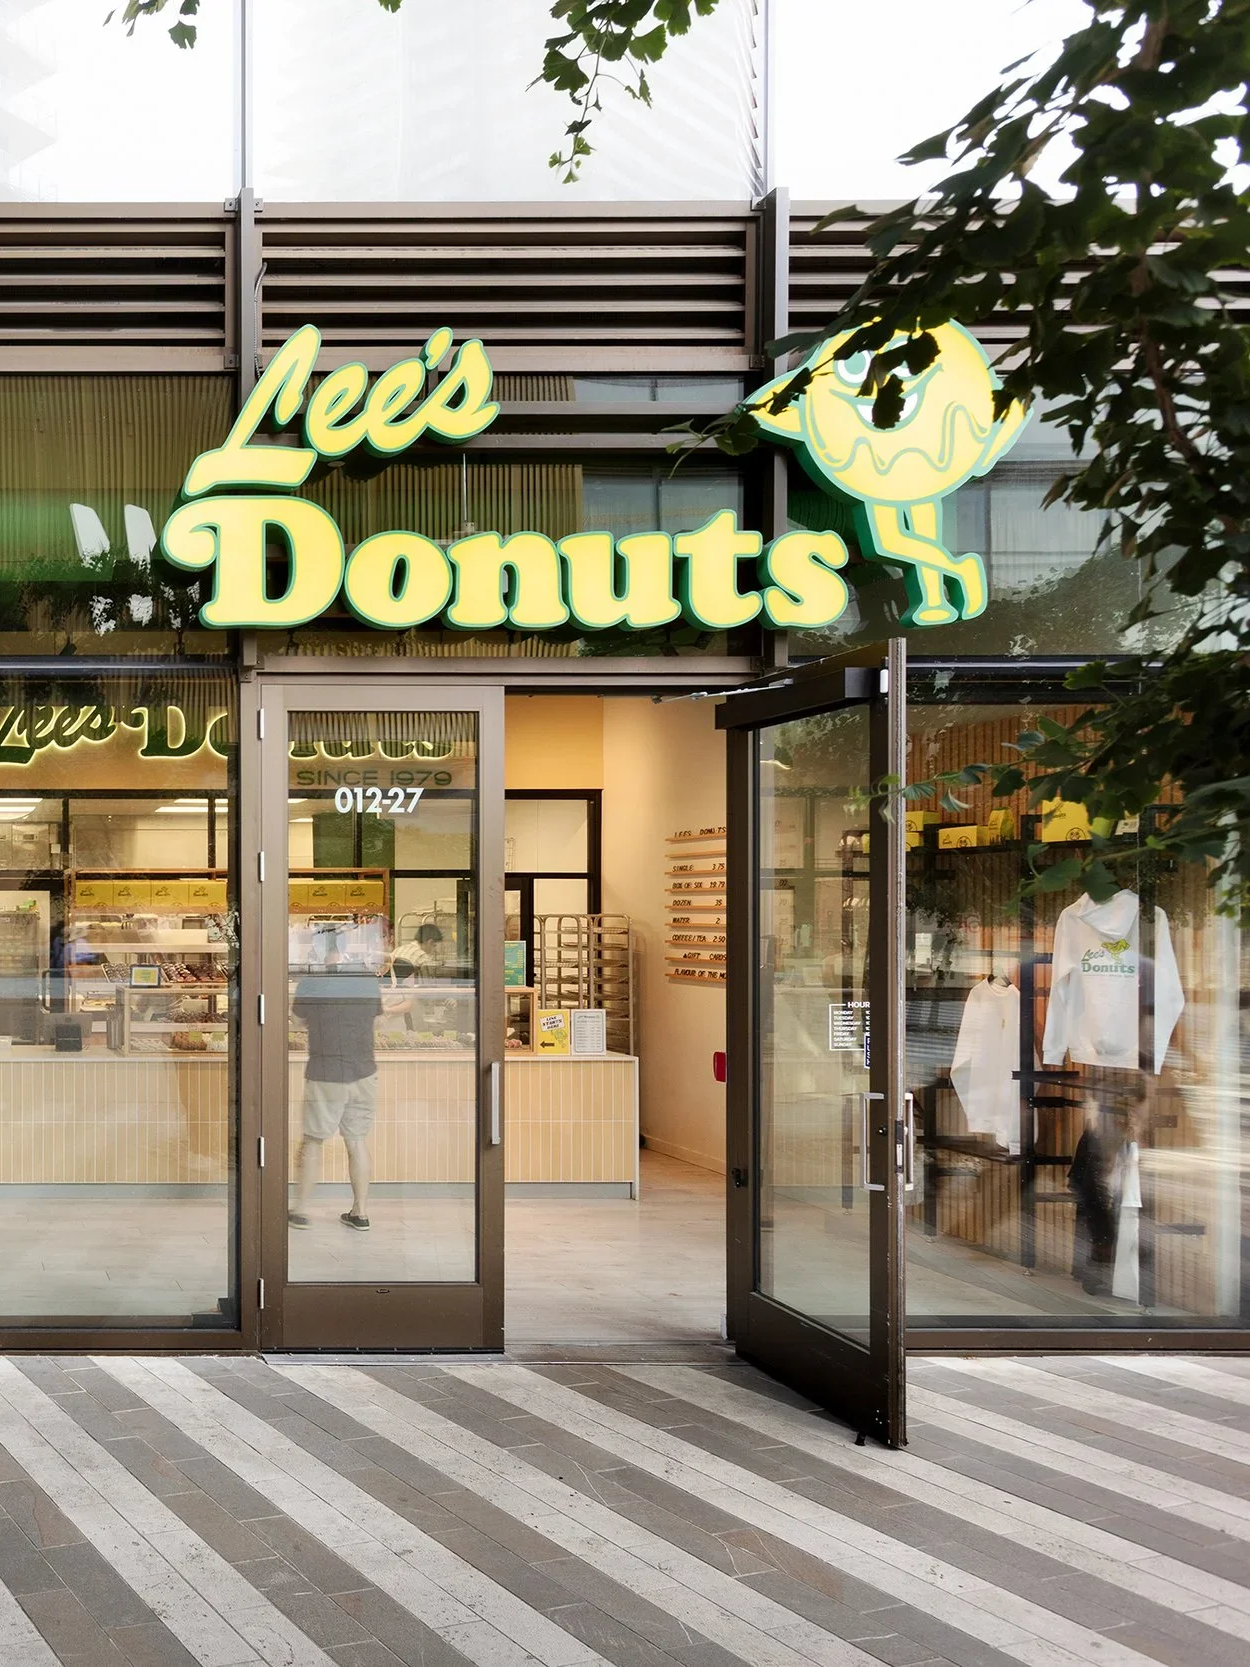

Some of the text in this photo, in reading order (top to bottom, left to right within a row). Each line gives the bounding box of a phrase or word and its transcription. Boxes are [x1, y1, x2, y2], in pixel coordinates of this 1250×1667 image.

[180, 323, 501, 499] Lee's
[160, 494, 851, 630] Donuts
[296, 769, 453, 787] SINCE 1979
[334, 786, 425, 814] 012-27
[672, 864, 694, 873] SINGLE
[672, 899, 692, 907] DOZEN
[715, 917, 721, 925] 2
[697, 970, 706, 978] OF
[1081, 962, 1135, 974] Donuts
